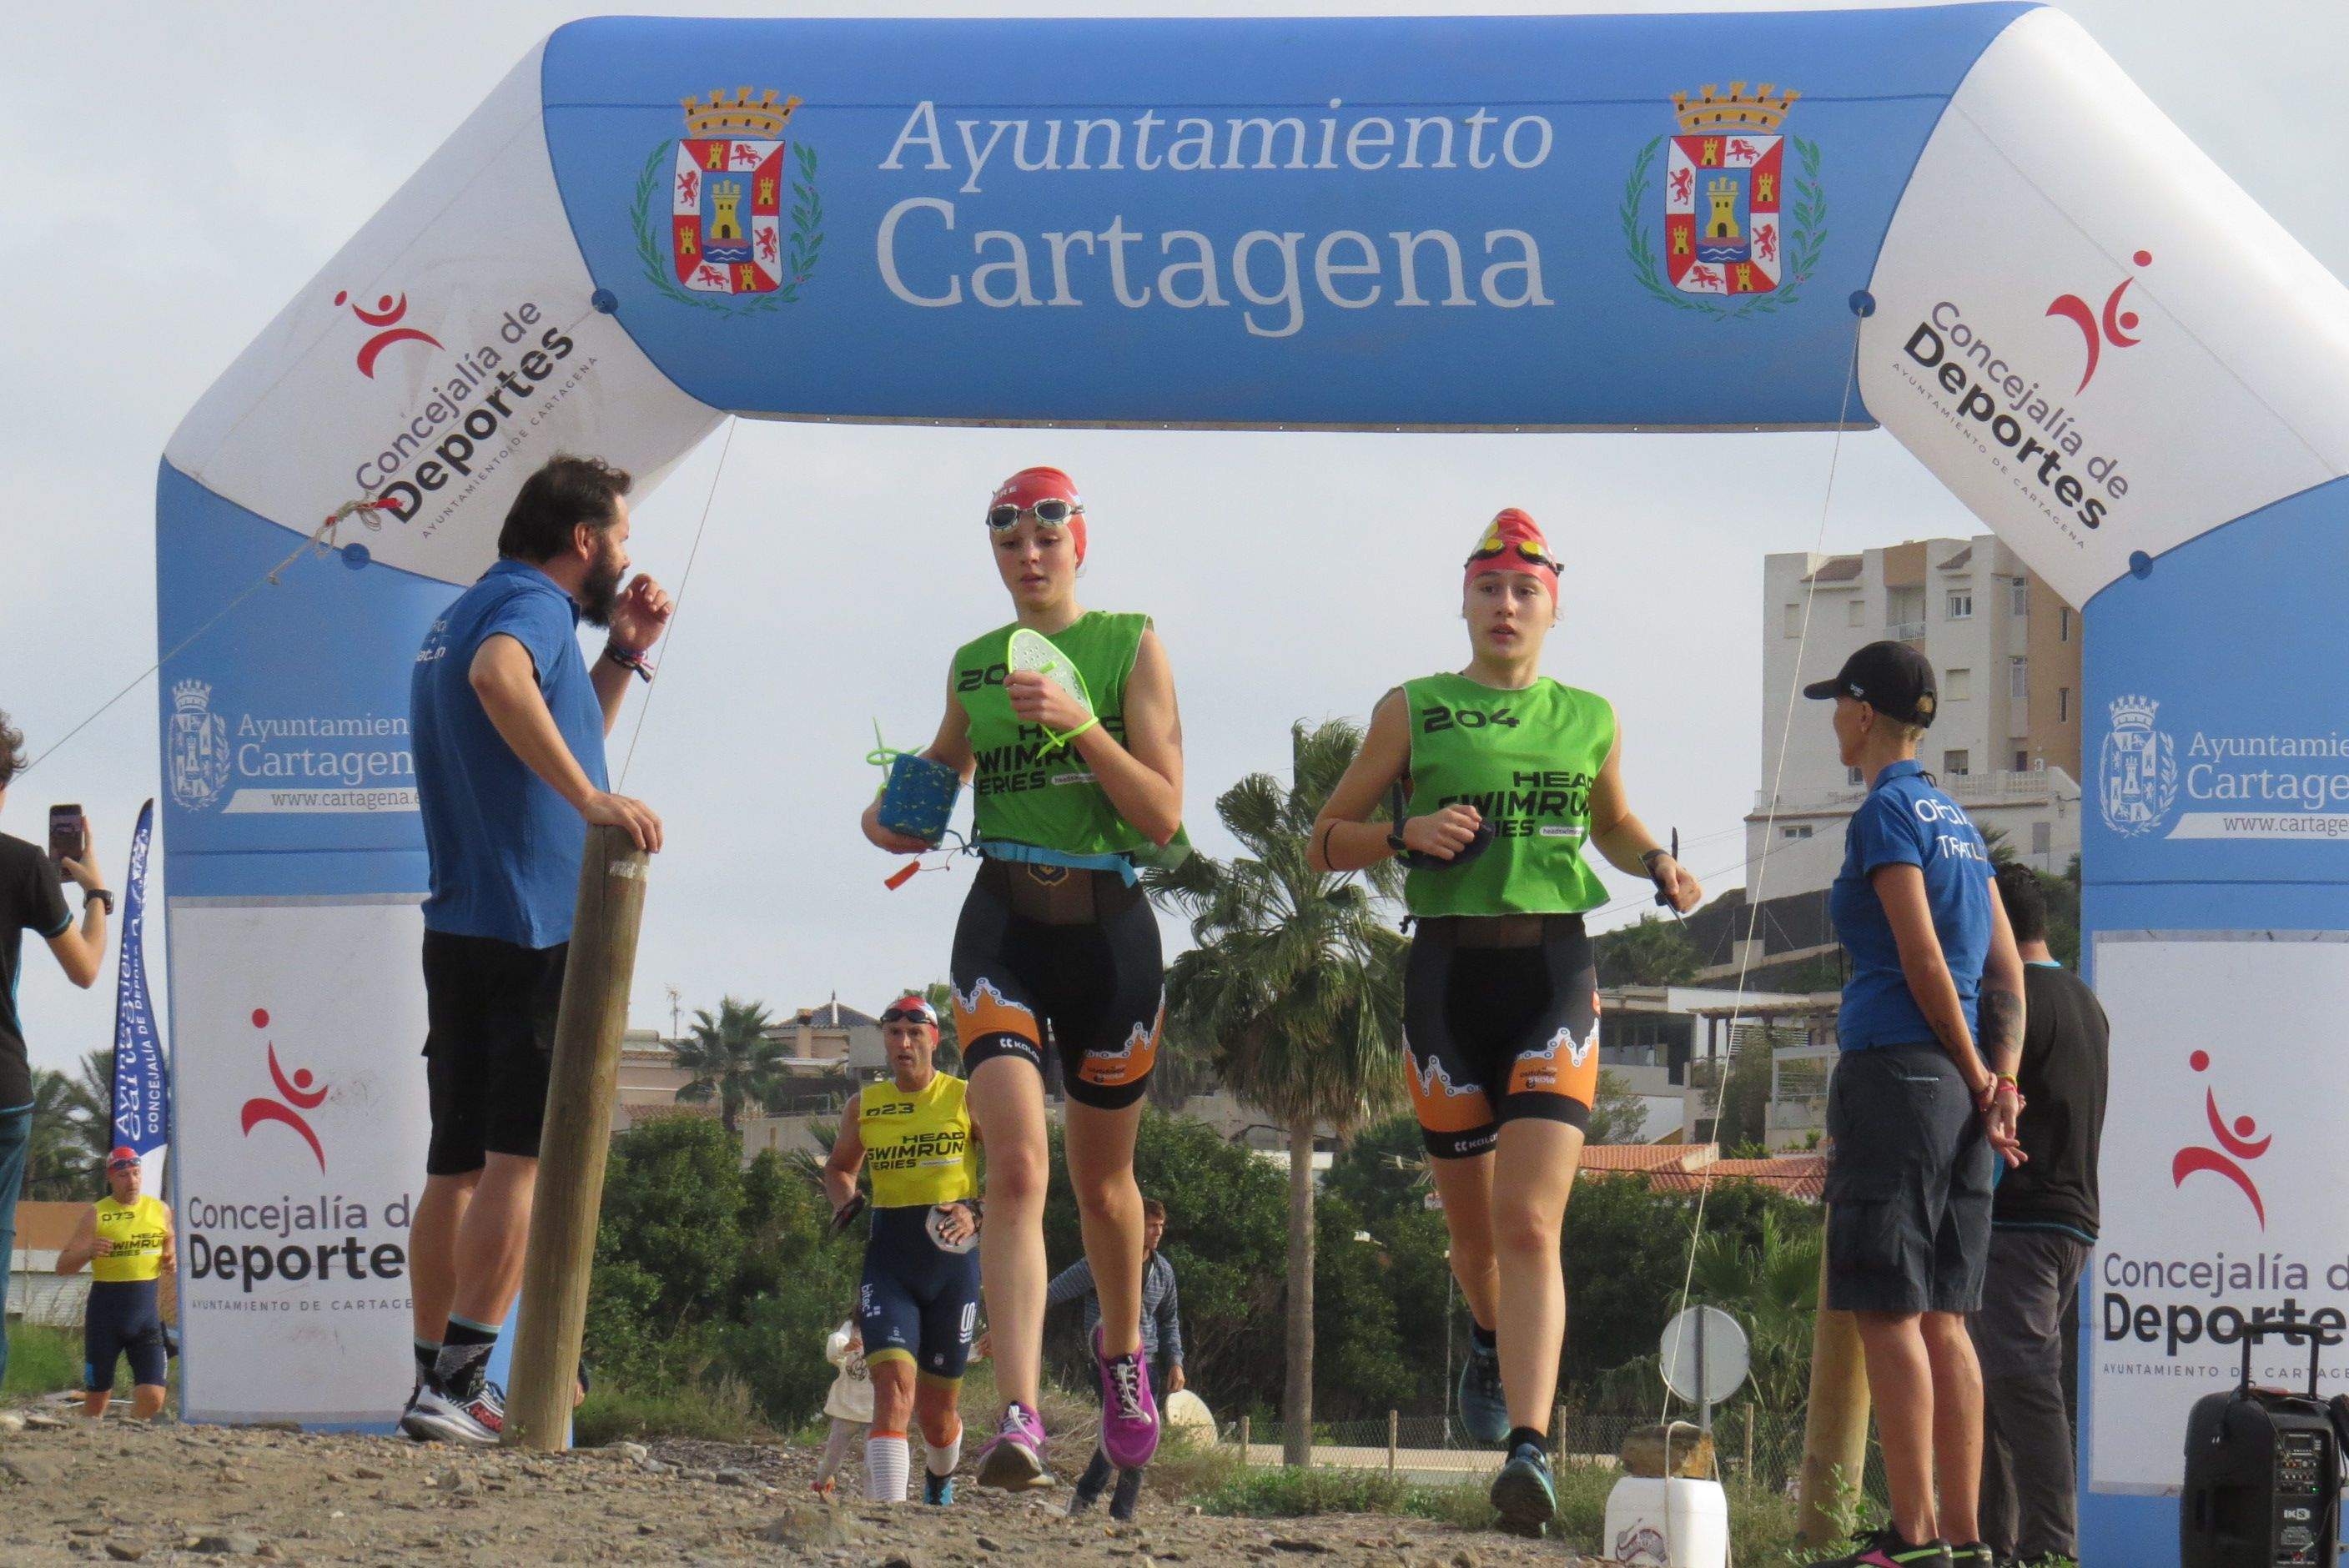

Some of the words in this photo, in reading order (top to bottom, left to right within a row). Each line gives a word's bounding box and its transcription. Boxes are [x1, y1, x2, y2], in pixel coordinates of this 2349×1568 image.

[878, 97, 1553, 193] Ayuntamiento
[877, 197, 1555, 338] Cartagena
[356, 346, 502, 490] Concejalía
[500, 302, 541, 344] de
[378, 327, 574, 524] Deportes
[1904, 321, 2107, 530] Deportes
[1932, 301, 2083, 457] Concejalía
[2087, 456, 2128, 500] de
[422, 450, 509, 539] AYUNTAMIENTO
[511, 430, 528, 446] DE
[531, 356, 598, 426] CARTAGENA
[1892, 363, 1987, 453] AYUNTAMIENTO
[1992, 457, 2009, 474] DE
[2013, 478, 2085, 549] CARTAGENA
[1422, 706, 1520, 734] 204
[238, 743, 416, 786] Cartagen
[902, 1131, 965, 1143] HEAD
[189, 1195, 368, 1239] Concejalía
[189, 1234, 406, 1293] Deporte
[2104, 1251, 2308, 1299] Concejalía
[192, 1299, 290, 1312] AYUNTAMIENTO
[300, 1300, 321, 1311] DE
[2104, 1292, 2347, 1356] Deporte
[2103, 1363, 2219, 1377] AYUNTAMIENTO
